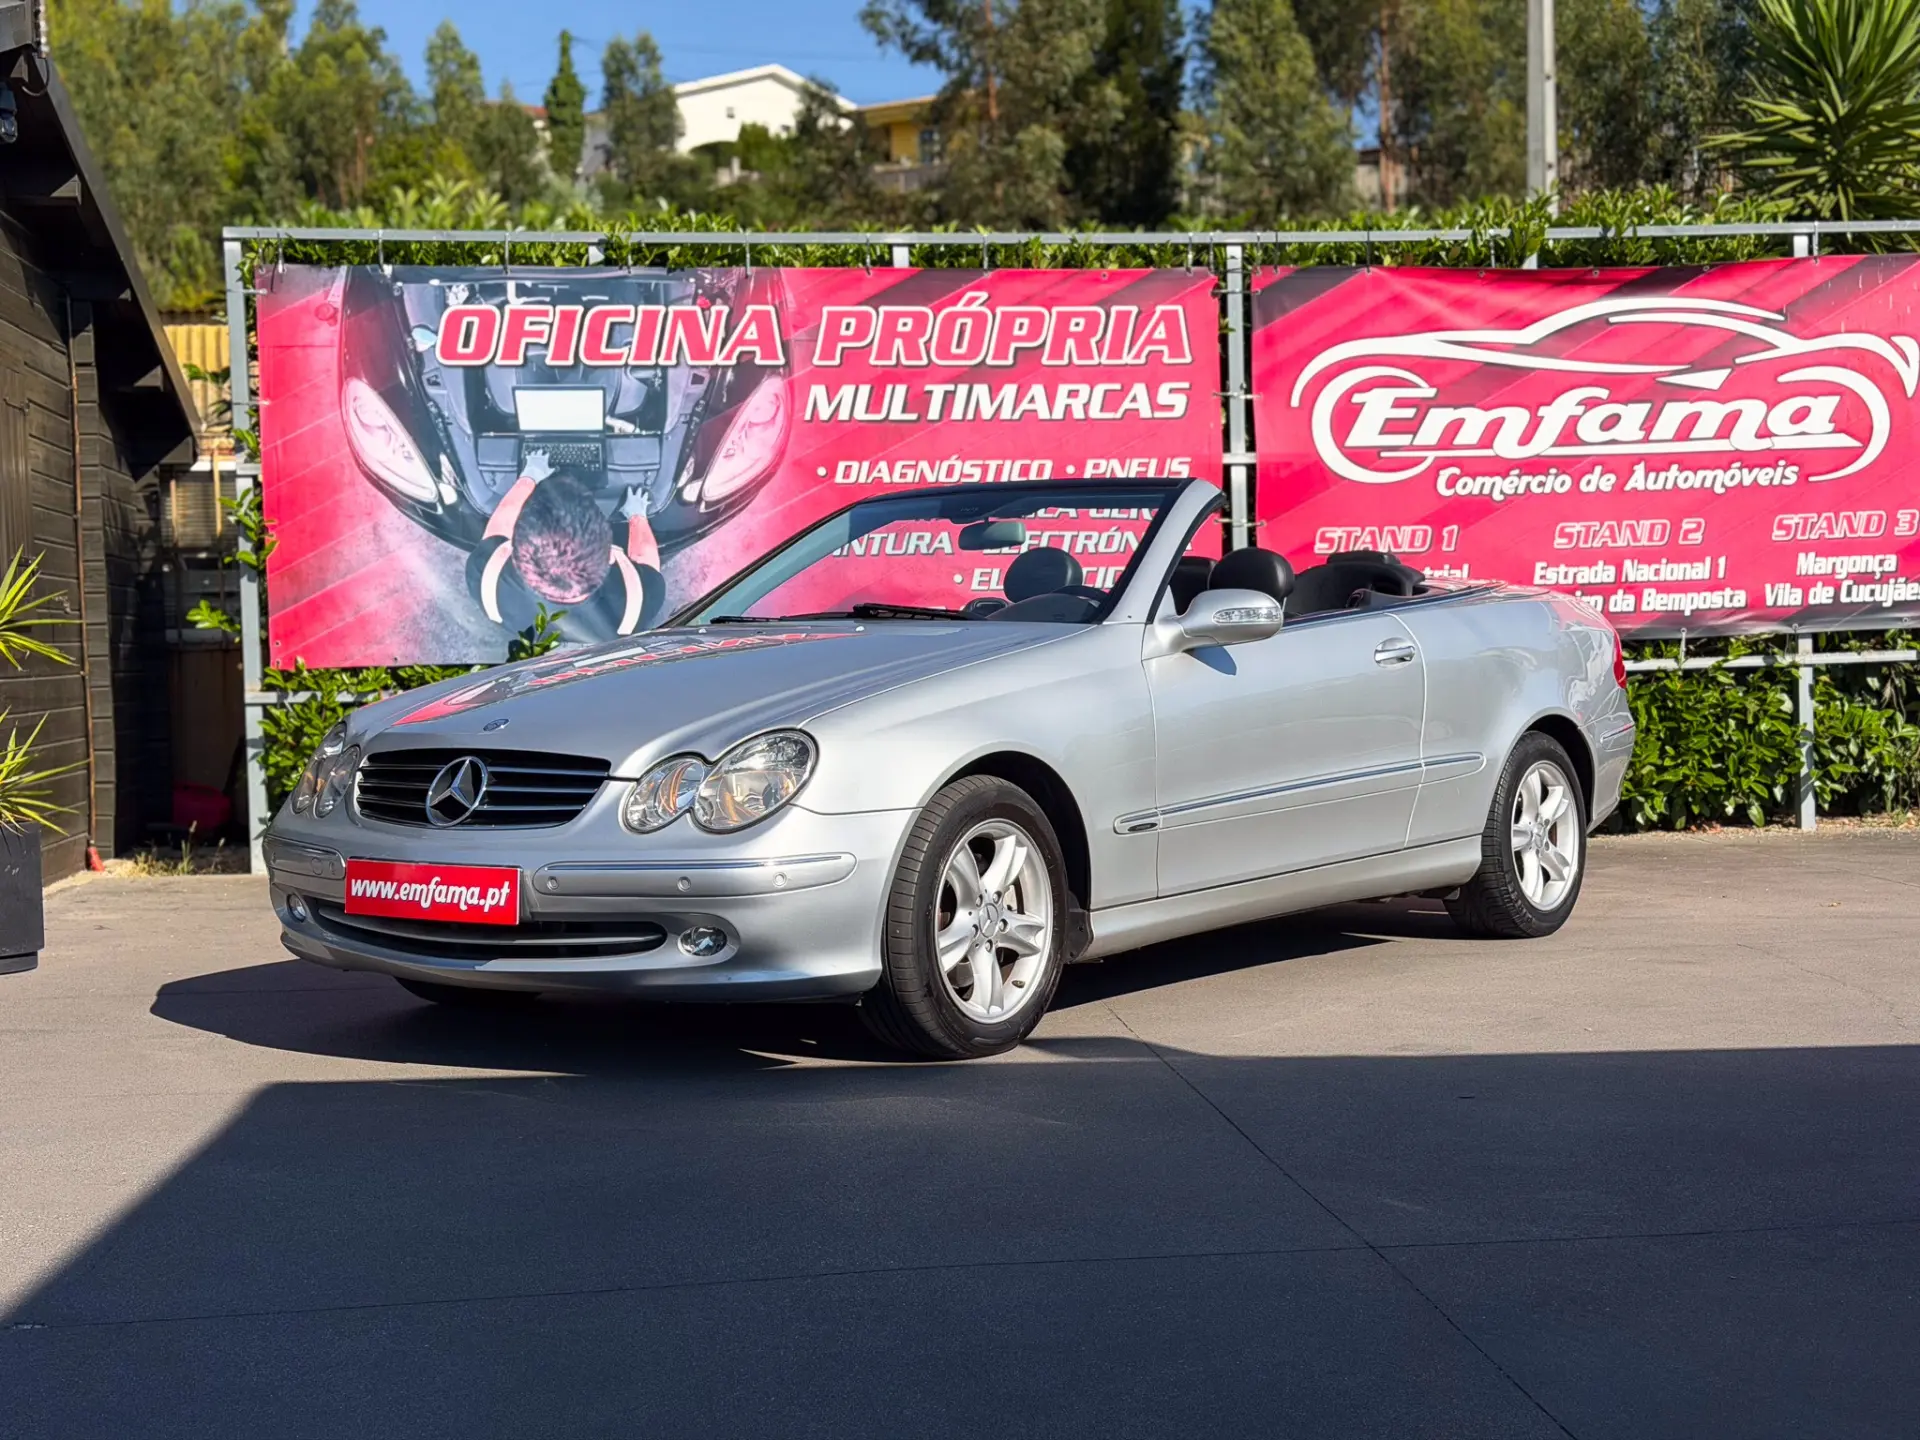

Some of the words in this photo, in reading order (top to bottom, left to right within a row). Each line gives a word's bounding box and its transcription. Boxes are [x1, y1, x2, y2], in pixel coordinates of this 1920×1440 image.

[435, 304, 785, 367] OFICINA
[812, 291, 1193, 366] PRÓPRIA
[804, 382, 1190, 421] MULTIMARCAS
[1343, 386, 1842, 459] Emfama
[834, 455, 1053, 483] DIAGNÓSTICO
[1083, 457, 1192, 478] PNEUS
[1436, 466, 1572, 500] Comércio
[1579, 465, 1613, 493] de
[1624, 460, 1799, 494] Automóveis
[1314, 526, 1431, 553] STAND
[1441, 525, 1459, 551] 1
[1553, 519, 1670, 549] STAND
[1678, 518, 1705, 545] 2
[1771, 511, 1887, 541] STAND
[1894, 509, 1919, 536] 3
[1533, 560, 1616, 585] Estrada
[1621, 556, 1711, 583] Nacional
[1717, 555, 1727, 579] 1
[1796, 552, 1897, 579] Margonça
[1609, 589, 1635, 612] da
[1641, 587, 1747, 616] Bemposta
[1765, 583, 1803, 607] Vila
[1808, 581, 1834, 605] de
[351, 876, 510, 912] www.emfama.pt
